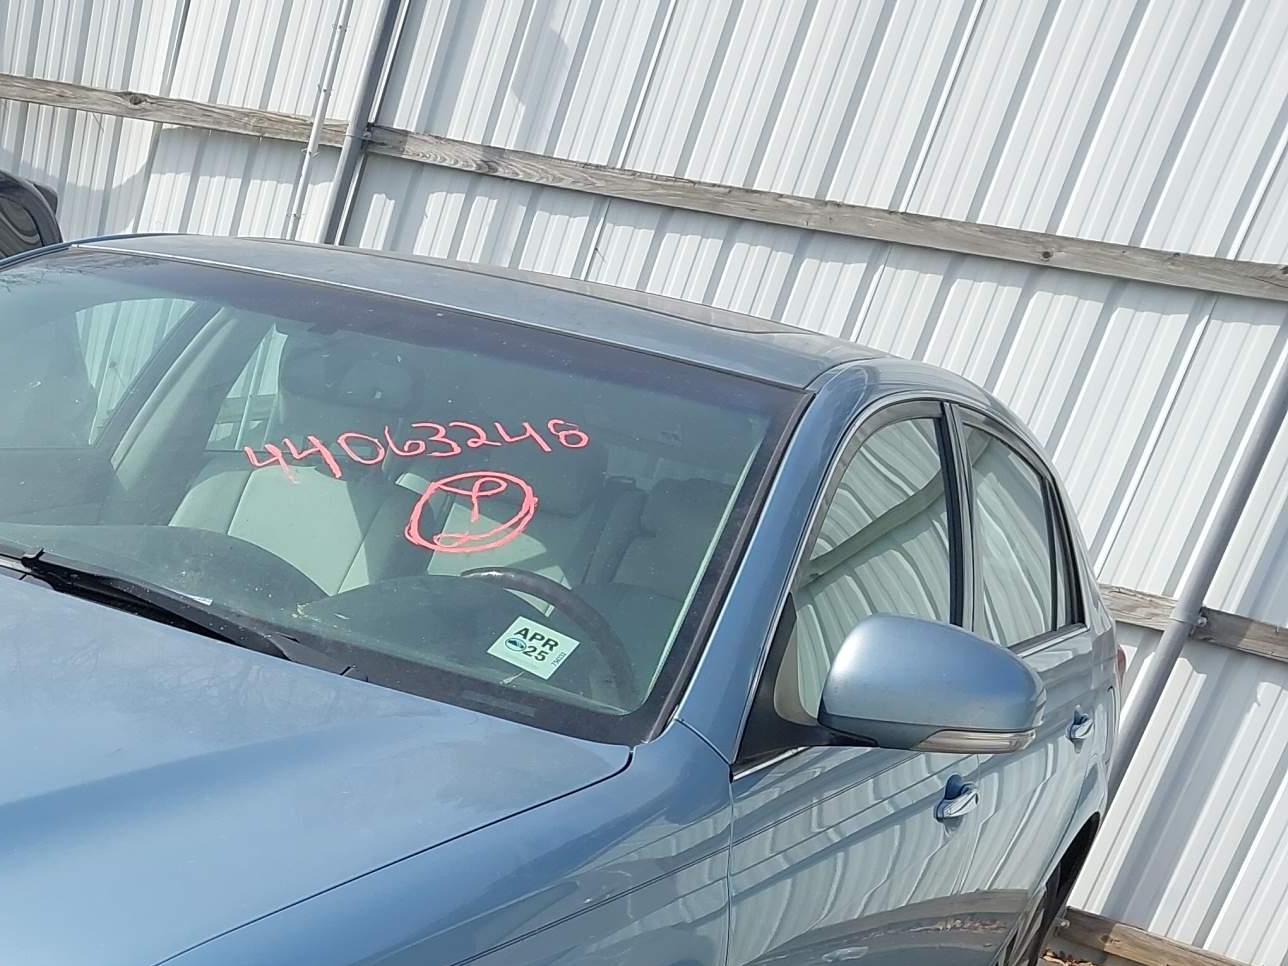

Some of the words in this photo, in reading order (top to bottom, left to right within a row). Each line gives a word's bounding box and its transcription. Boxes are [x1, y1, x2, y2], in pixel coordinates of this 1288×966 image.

[244, 419, 589, 484] 44063248
[513, 626, 559, 652] APR
[522, 645, 549, 662] 25
